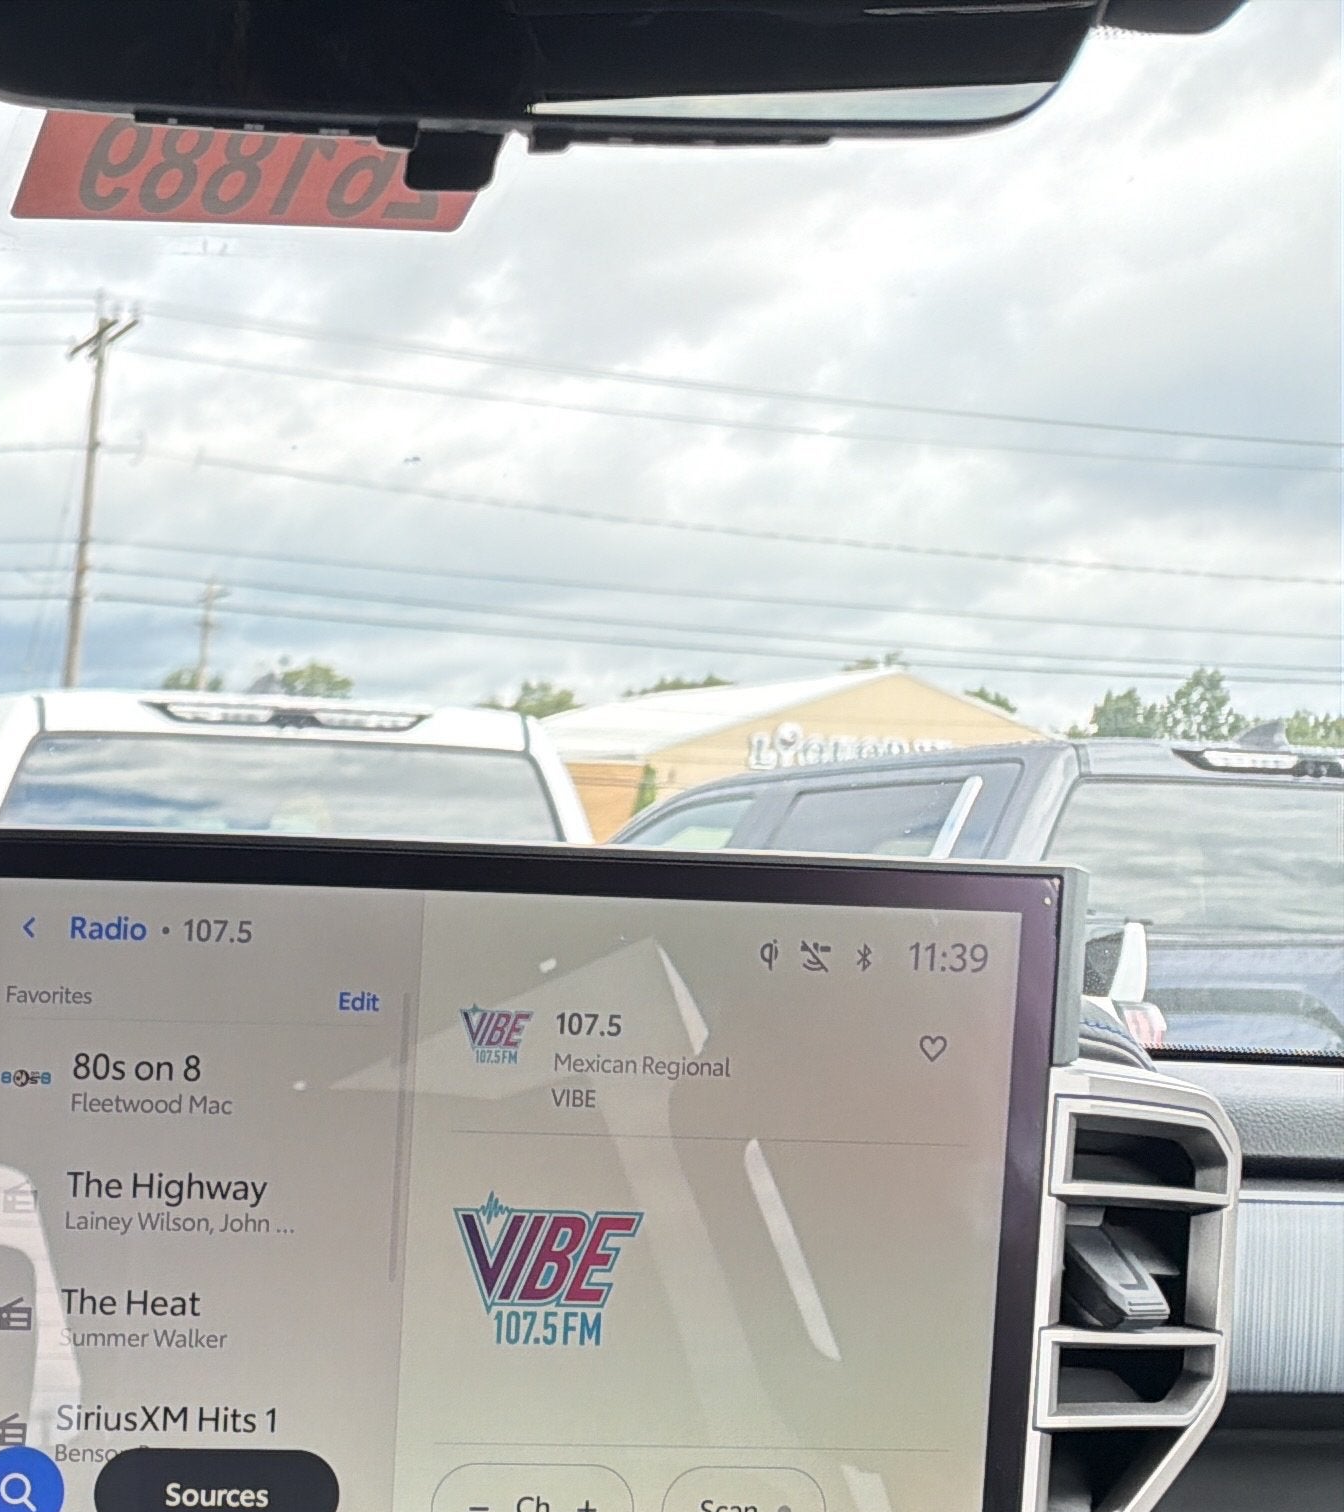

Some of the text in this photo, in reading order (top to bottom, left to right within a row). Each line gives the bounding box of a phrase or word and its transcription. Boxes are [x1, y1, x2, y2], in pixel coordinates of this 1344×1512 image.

[70, 916, 253, 944] Radio 107.5
[909, 942, 989, 974] 11:39
[5, 985, 93, 1006] Favorites
[338, 991, 380, 1013] Edit
[459, 1008, 535, 1050] VIBE
[556, 1012, 623, 1037] 107.5
[72, 1053, 202, 1082] 80s on 8
[554, 1053, 731, 1080] Mexican Regional
[70, 1092, 233, 1116] Fleetwood Mac
[551, 1088, 597, 1109] VIBE
[66, 1171, 269, 1208] The Highway
[64, 1211, 135, 1237] Lainey
[137, 1213, 215, 1237] Wilson,
[219, 1214, 271, 1235] John
[453, 1206, 645, 1314] VIBE
[61, 1288, 201, 1317] The Heat
[59, 1326, 228, 1350] Summer Walker
[55, 1404, 279, 1434] SiriusXM Hits 1
[54, 1443, 121, 1464] Benso
[165, 1483, 269, 1508] Sources
